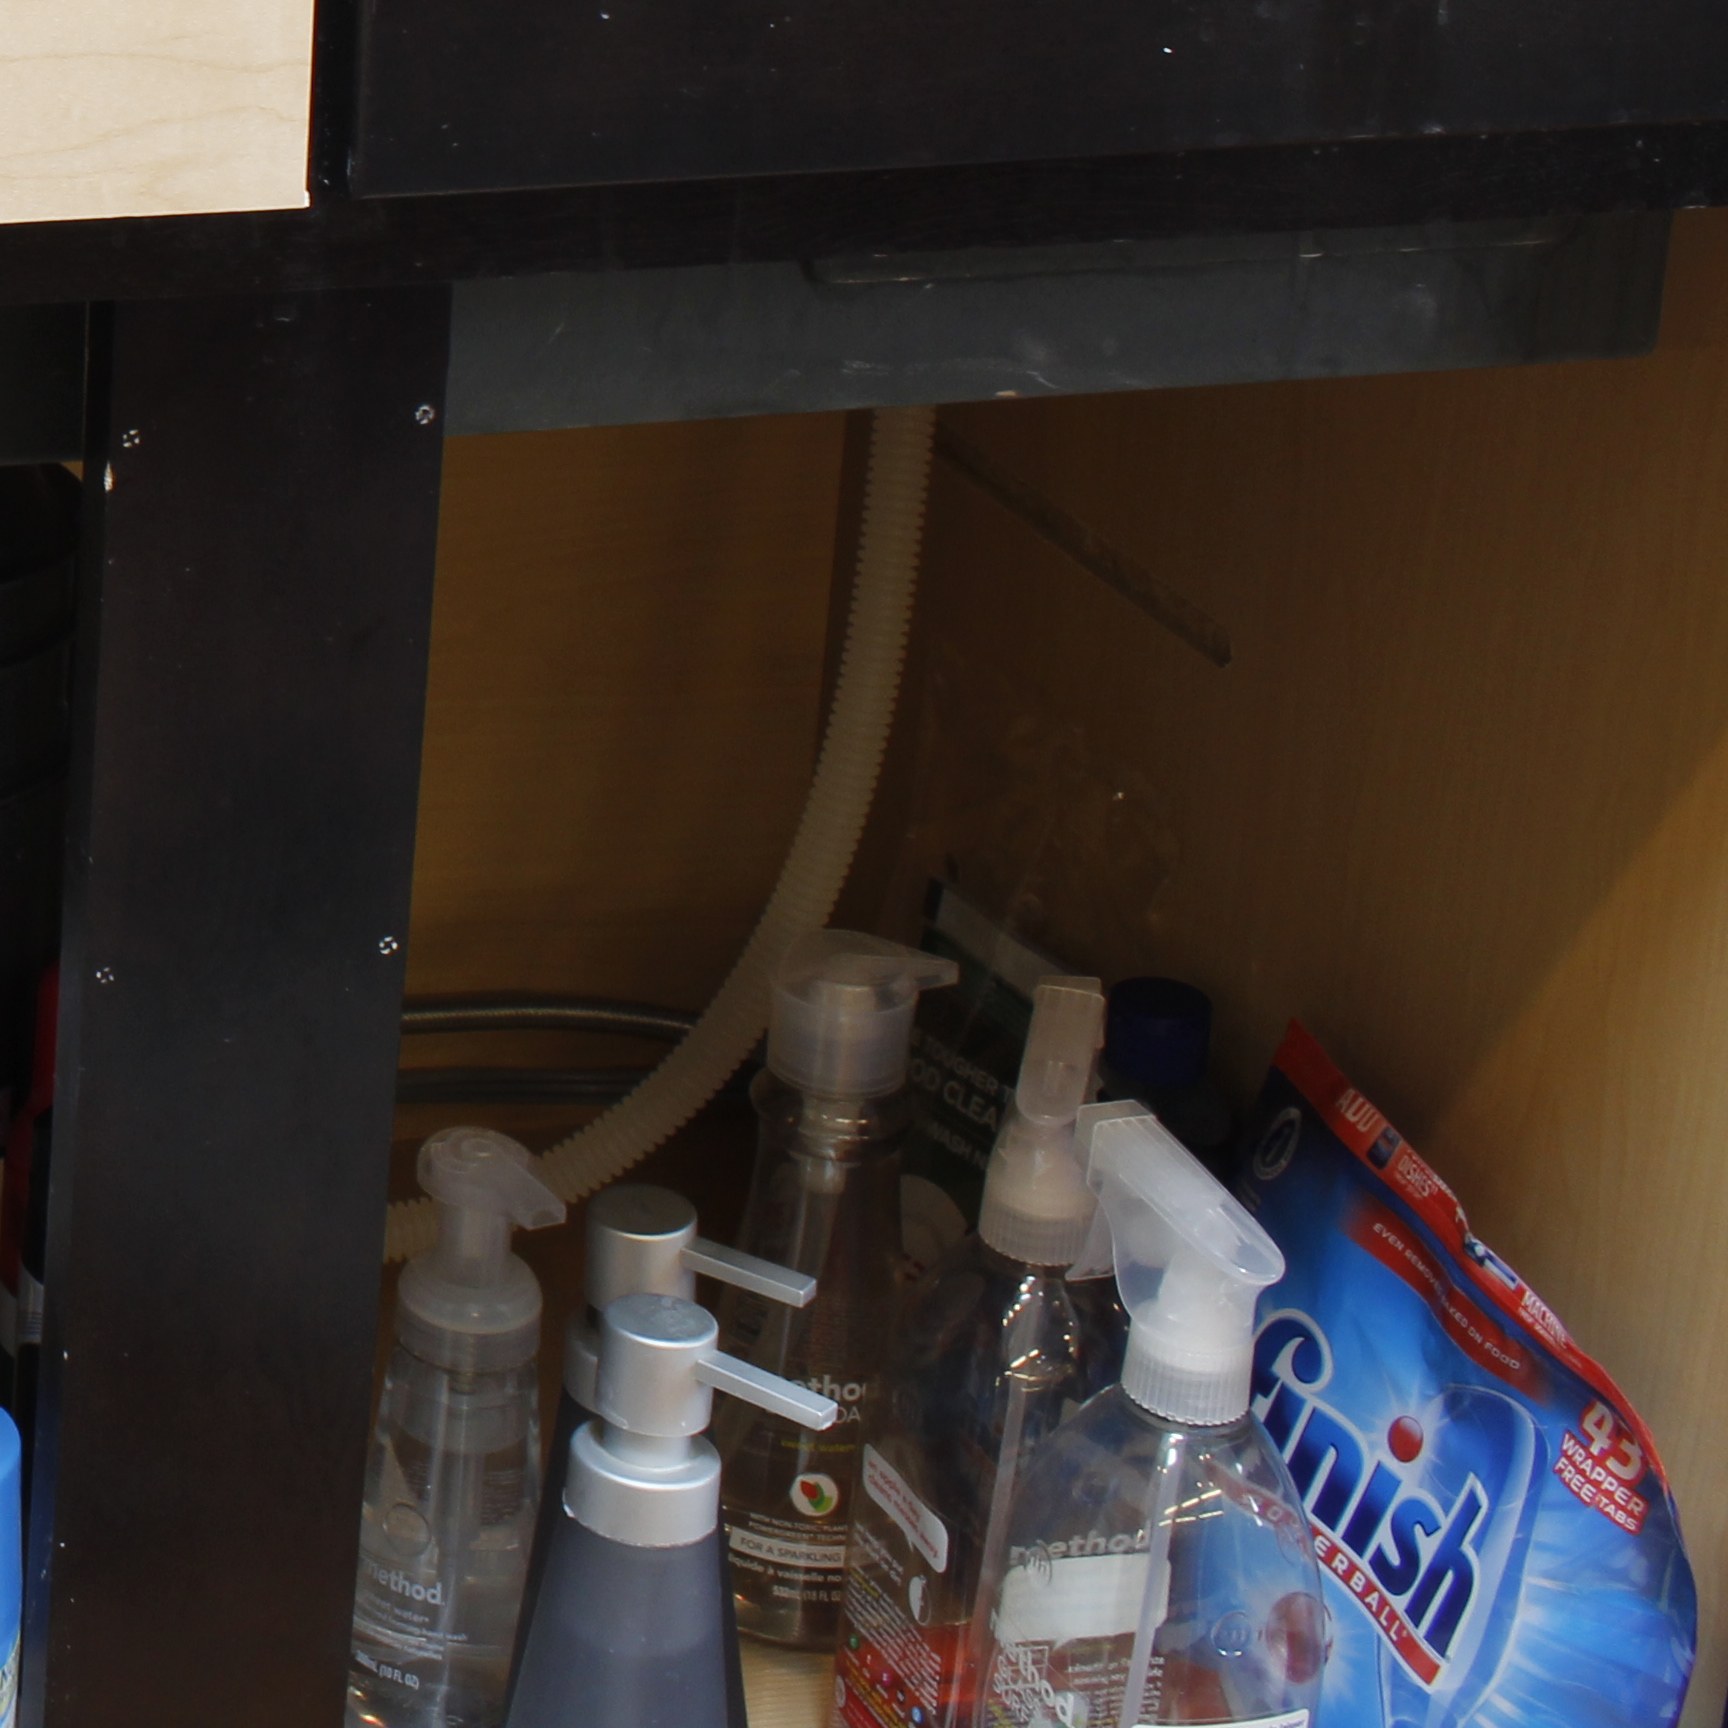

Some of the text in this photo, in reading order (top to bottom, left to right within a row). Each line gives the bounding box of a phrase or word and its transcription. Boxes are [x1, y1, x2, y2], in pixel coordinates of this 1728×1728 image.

[1373, 1223, 1405, 1251] EVEN
[1468, 1325, 1484, 1344] ON
[1484, 1341, 1521, 1370] FOOD
[1554, 1456, 1638, 1531] FREE TABS
[1562, 1432, 1645, 1516] WRAPPER
[739, 1536, 844, 1563] FOR A SPARKLING
